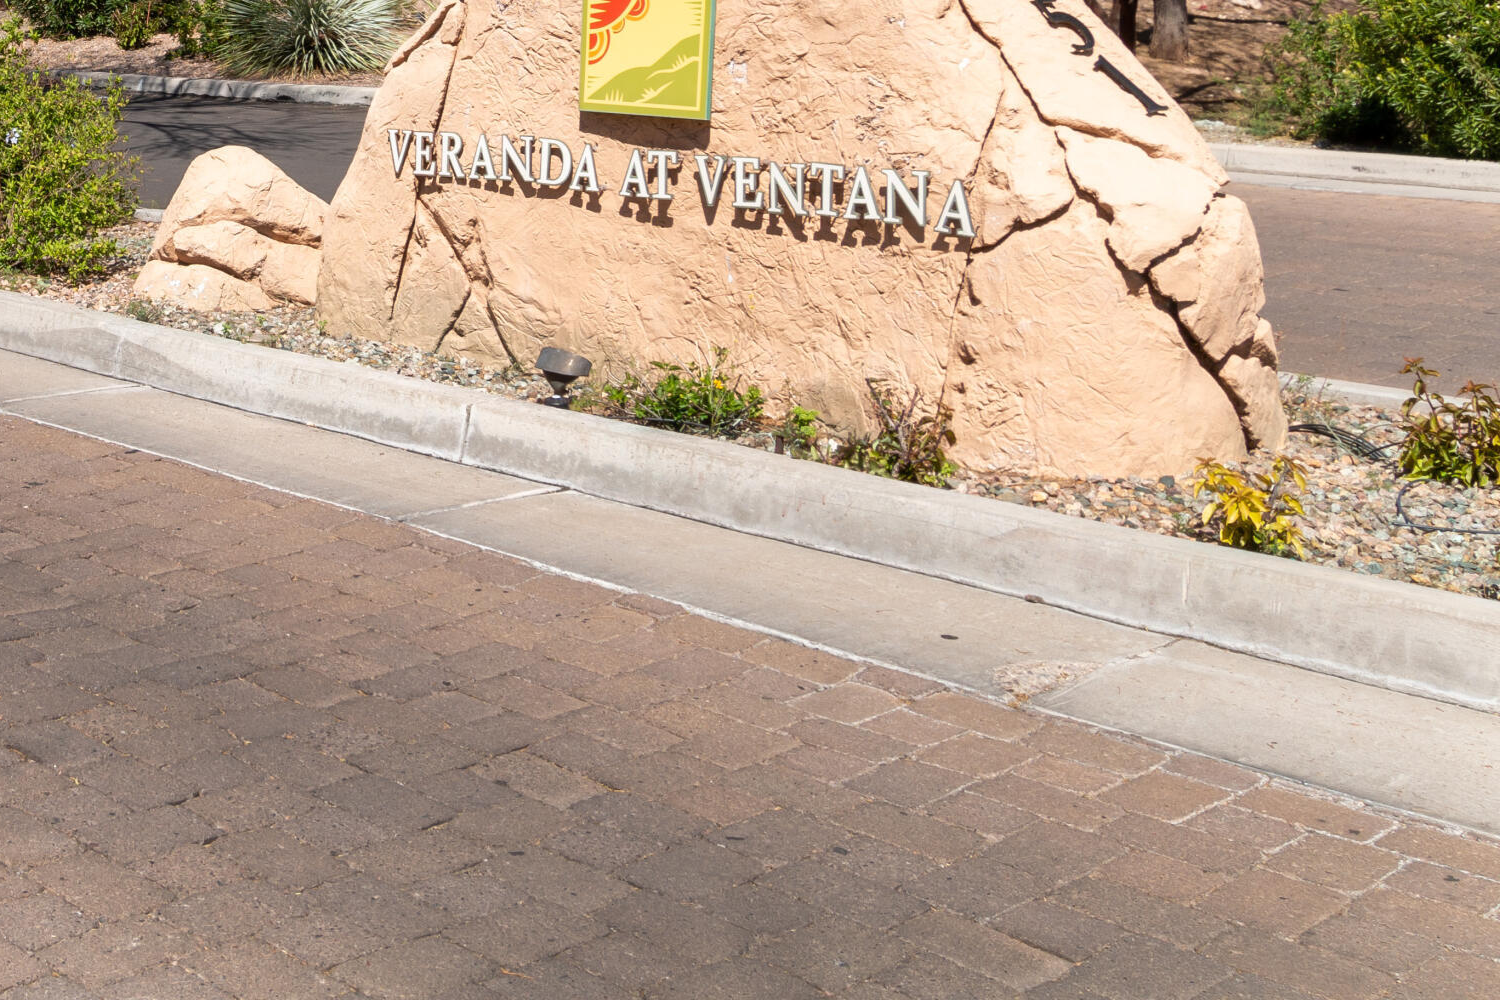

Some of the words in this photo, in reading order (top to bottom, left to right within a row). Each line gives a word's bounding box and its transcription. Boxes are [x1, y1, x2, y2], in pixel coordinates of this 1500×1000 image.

[387, 129, 601, 193] VERANDA
[620, 149, 678, 200] AT
[694, 155, 976, 238] VENTANA
